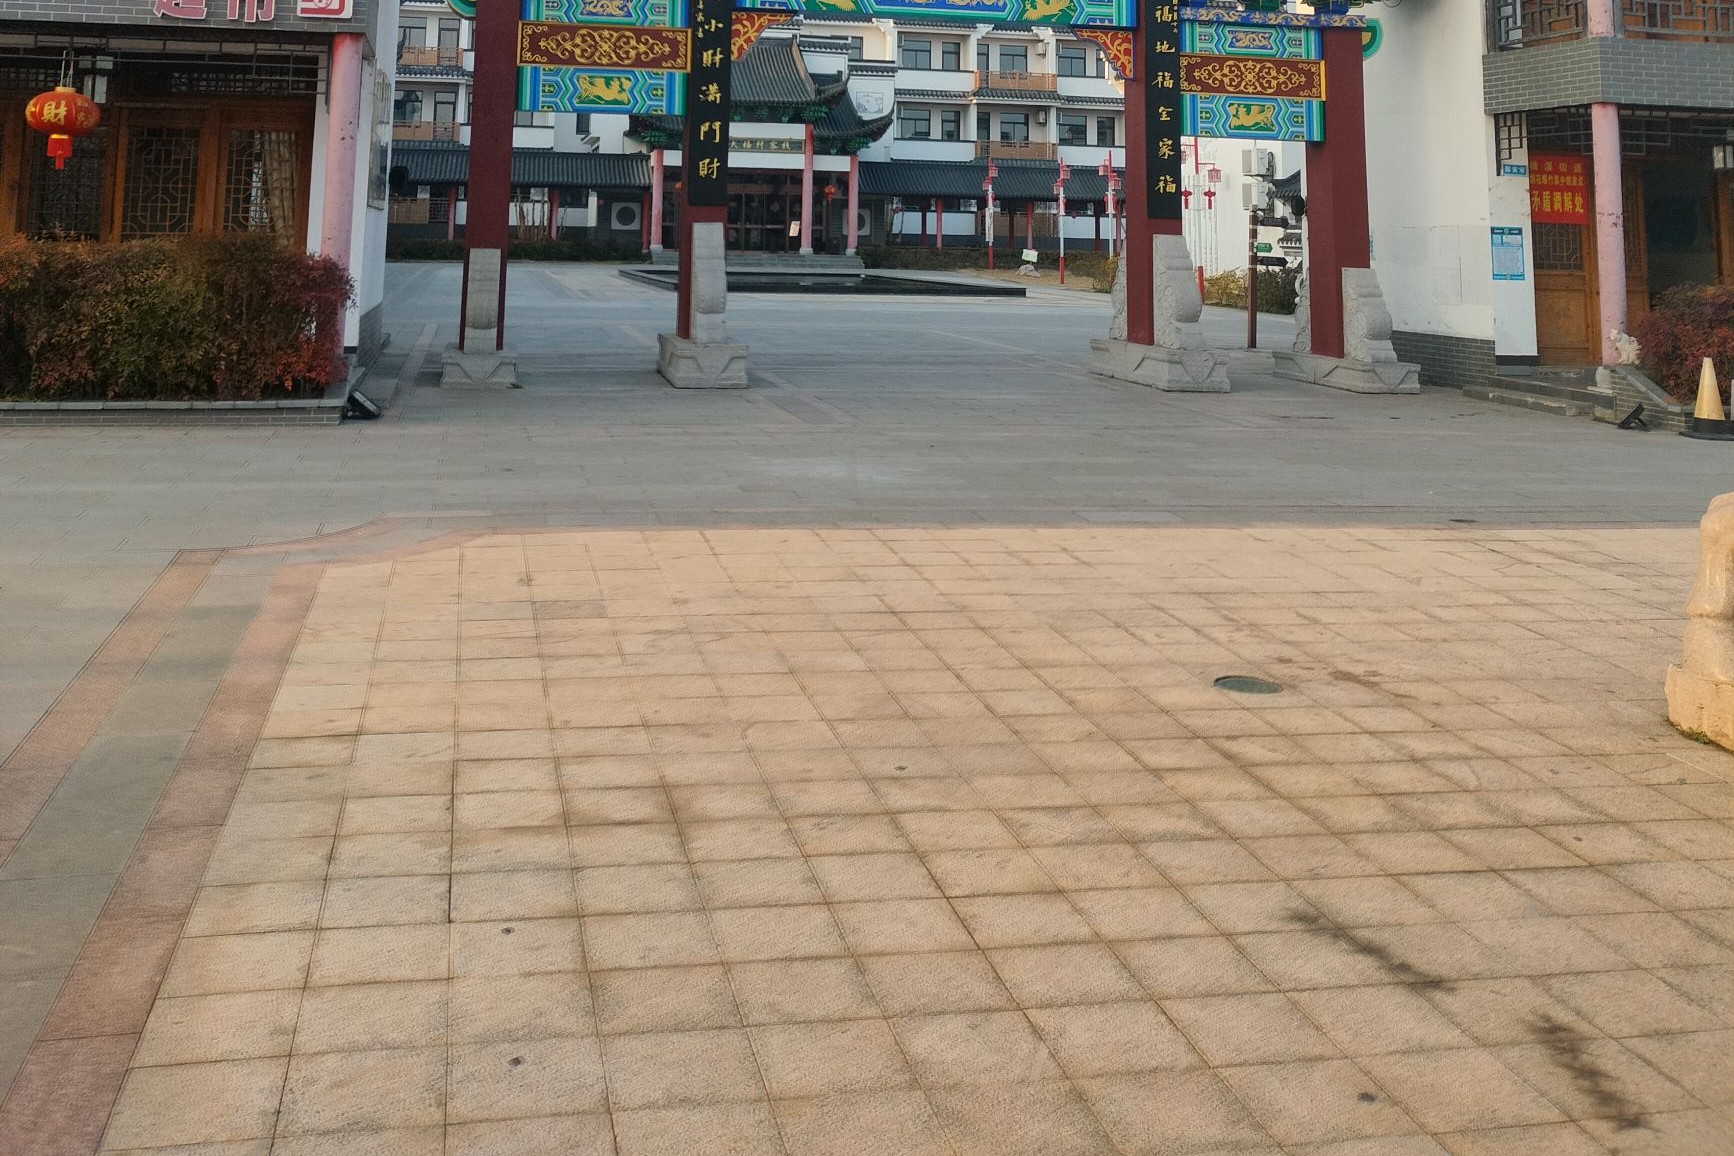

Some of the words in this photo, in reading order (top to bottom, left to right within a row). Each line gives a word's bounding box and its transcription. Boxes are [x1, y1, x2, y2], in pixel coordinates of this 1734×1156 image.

[1532, 190, 1584, 213] 矛盾调解处
